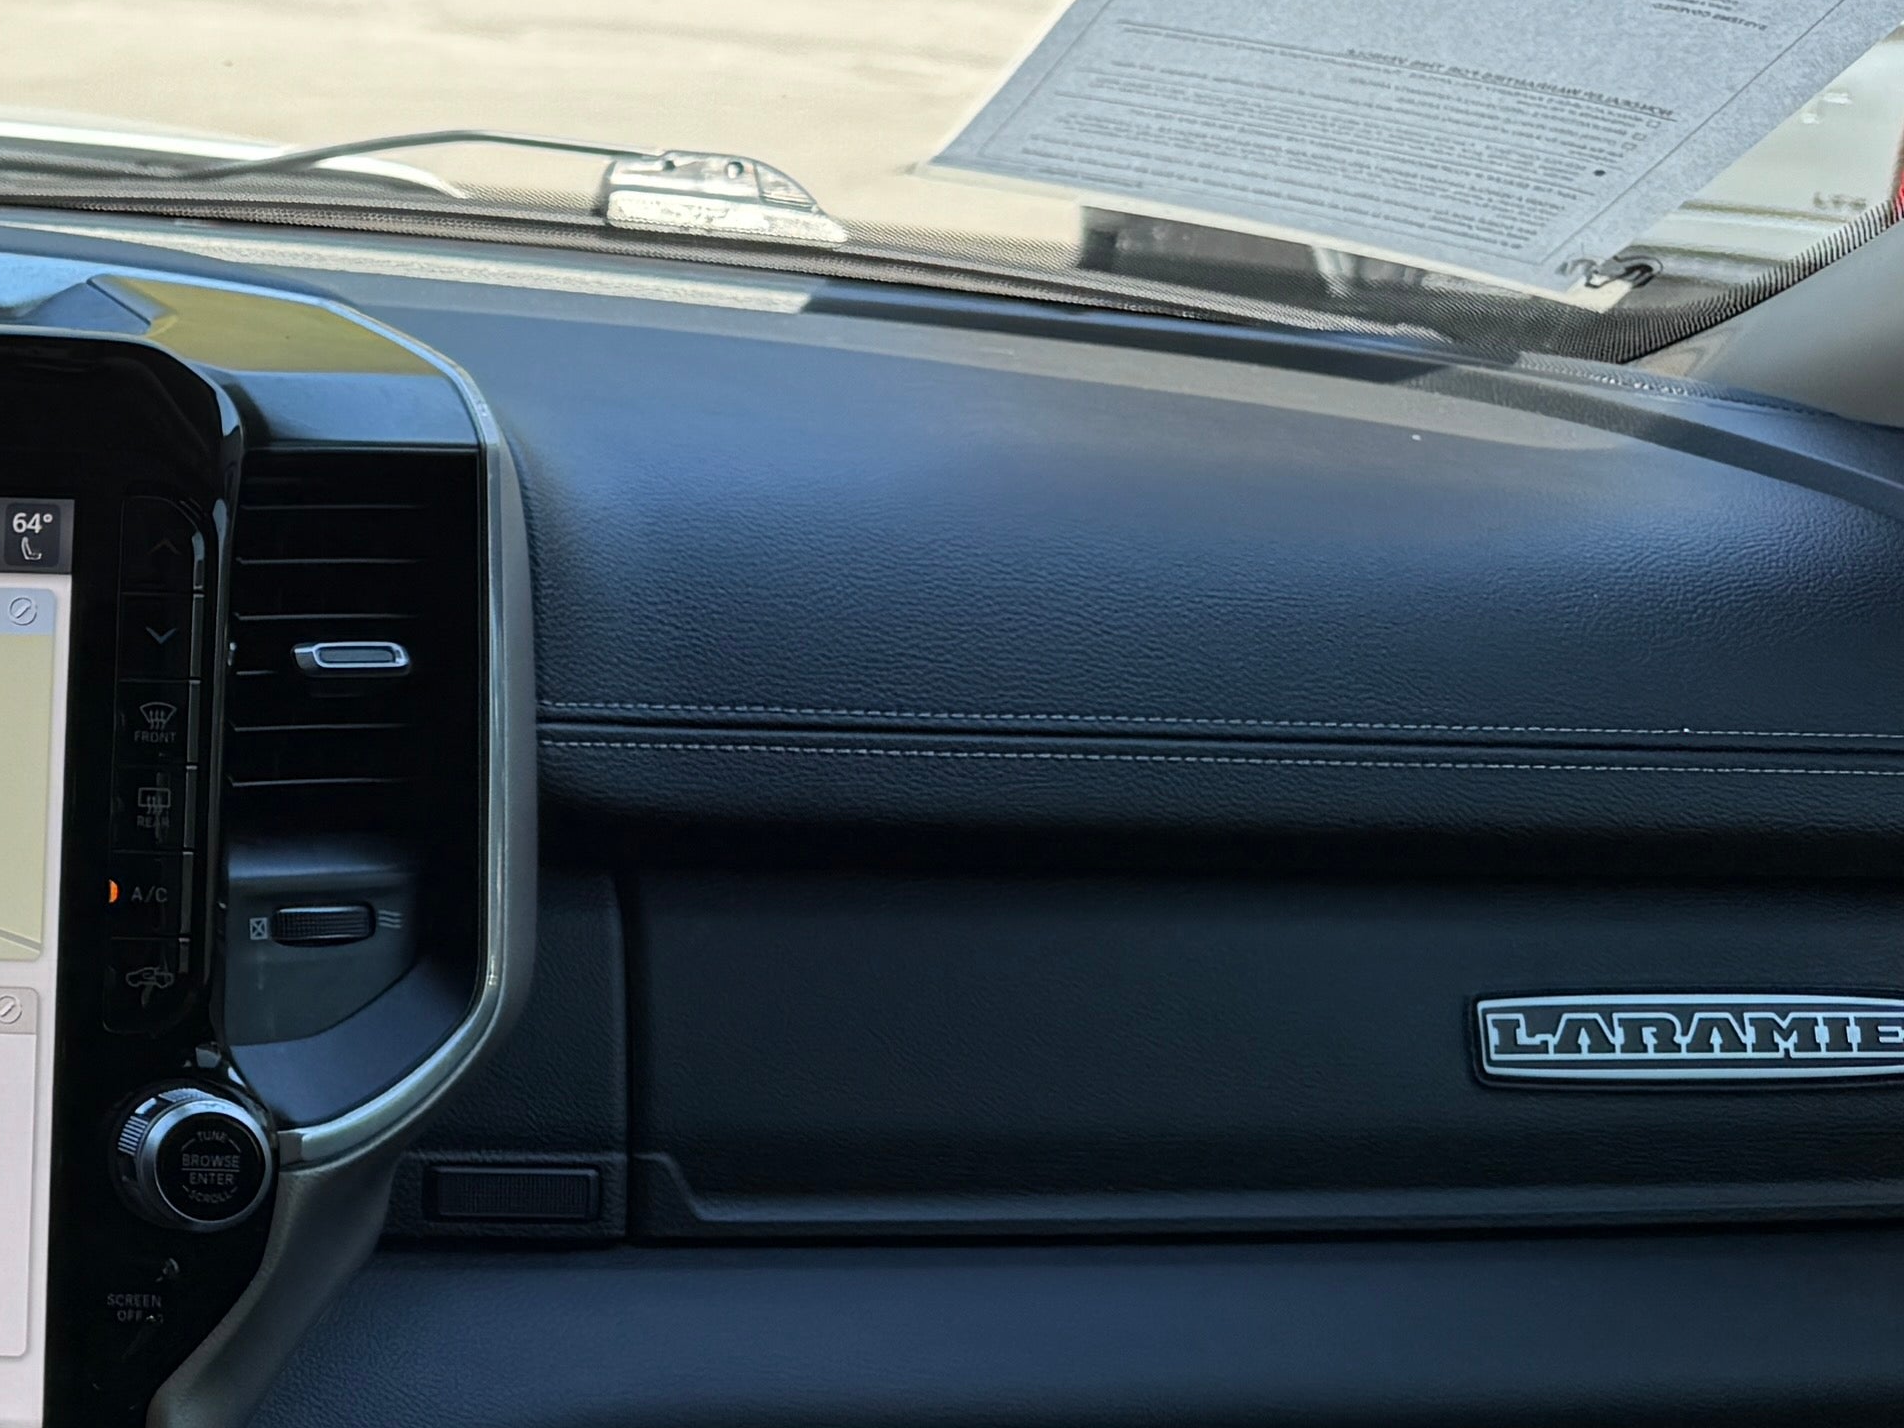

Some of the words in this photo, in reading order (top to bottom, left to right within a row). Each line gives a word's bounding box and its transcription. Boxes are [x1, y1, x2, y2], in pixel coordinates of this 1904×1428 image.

[133, 730, 177, 744] FRONT
[136, 815, 170, 828] REAR
[129, 885, 169, 904] A/C
[1485, 1012, 1904, 1061] LARAMIE
[181, 1153, 241, 1169] BROWSE
[188, 1172, 235, 1186] ENTER
[106, 1293, 162, 1309] SCREEN
[116, 1309, 143, 1323] OFF
